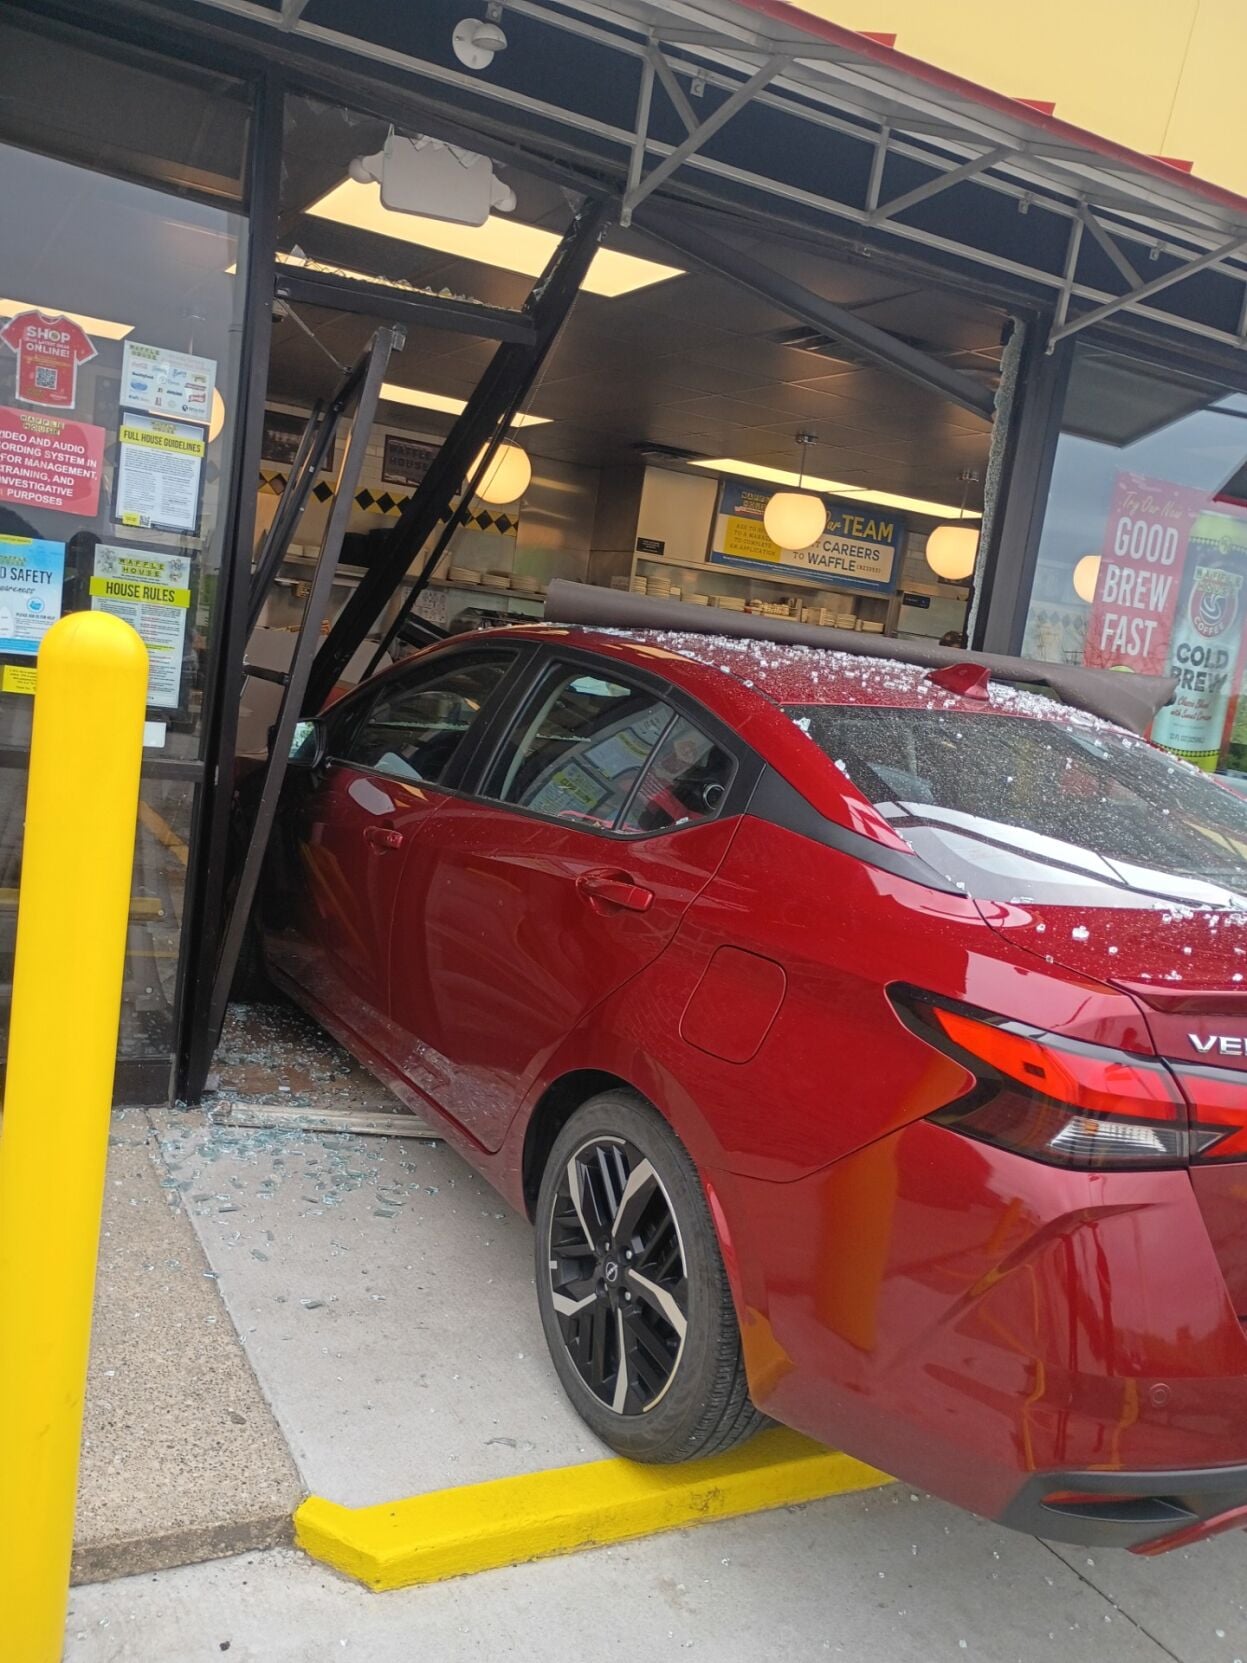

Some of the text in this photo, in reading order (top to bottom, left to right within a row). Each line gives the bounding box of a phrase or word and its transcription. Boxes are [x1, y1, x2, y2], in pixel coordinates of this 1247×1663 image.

[26, 325, 71, 343] SHOP
[26, 343, 70, 358] ONLINE!
[29, 436, 51, 447] AND
[52, 441, 85, 454] AUDIO
[123, 430, 201, 453] FULL HOUSE GUIDELINES
[0, 442, 97, 468] ORDING SYSTEM IN
[1, 453, 98, 481] FOR MANAGEMENT,
[52, 475, 74, 486] AND
[7, 488, 63, 506] PURPOSES
[842, 514, 895, 543] TEAM
[823, 541, 880, 561] CAREERS
[1114, 516, 1179, 566] GOOD
[119, 557, 165, 571] WAFFLE
[793, 551, 804, 560] TO
[808, 552, 856, 571] WAFFLE
[10, 567, 53, 585] SAFETY
[106, 581, 140, 598] HOUSE
[142, 586, 175, 603] RULES
[1102, 563, 1173, 612] BREW
[1101, 612, 1158, 657] FAST
[1194, 616, 1225, 636] COFFEE
[1177, 643, 1229, 669] COLD
